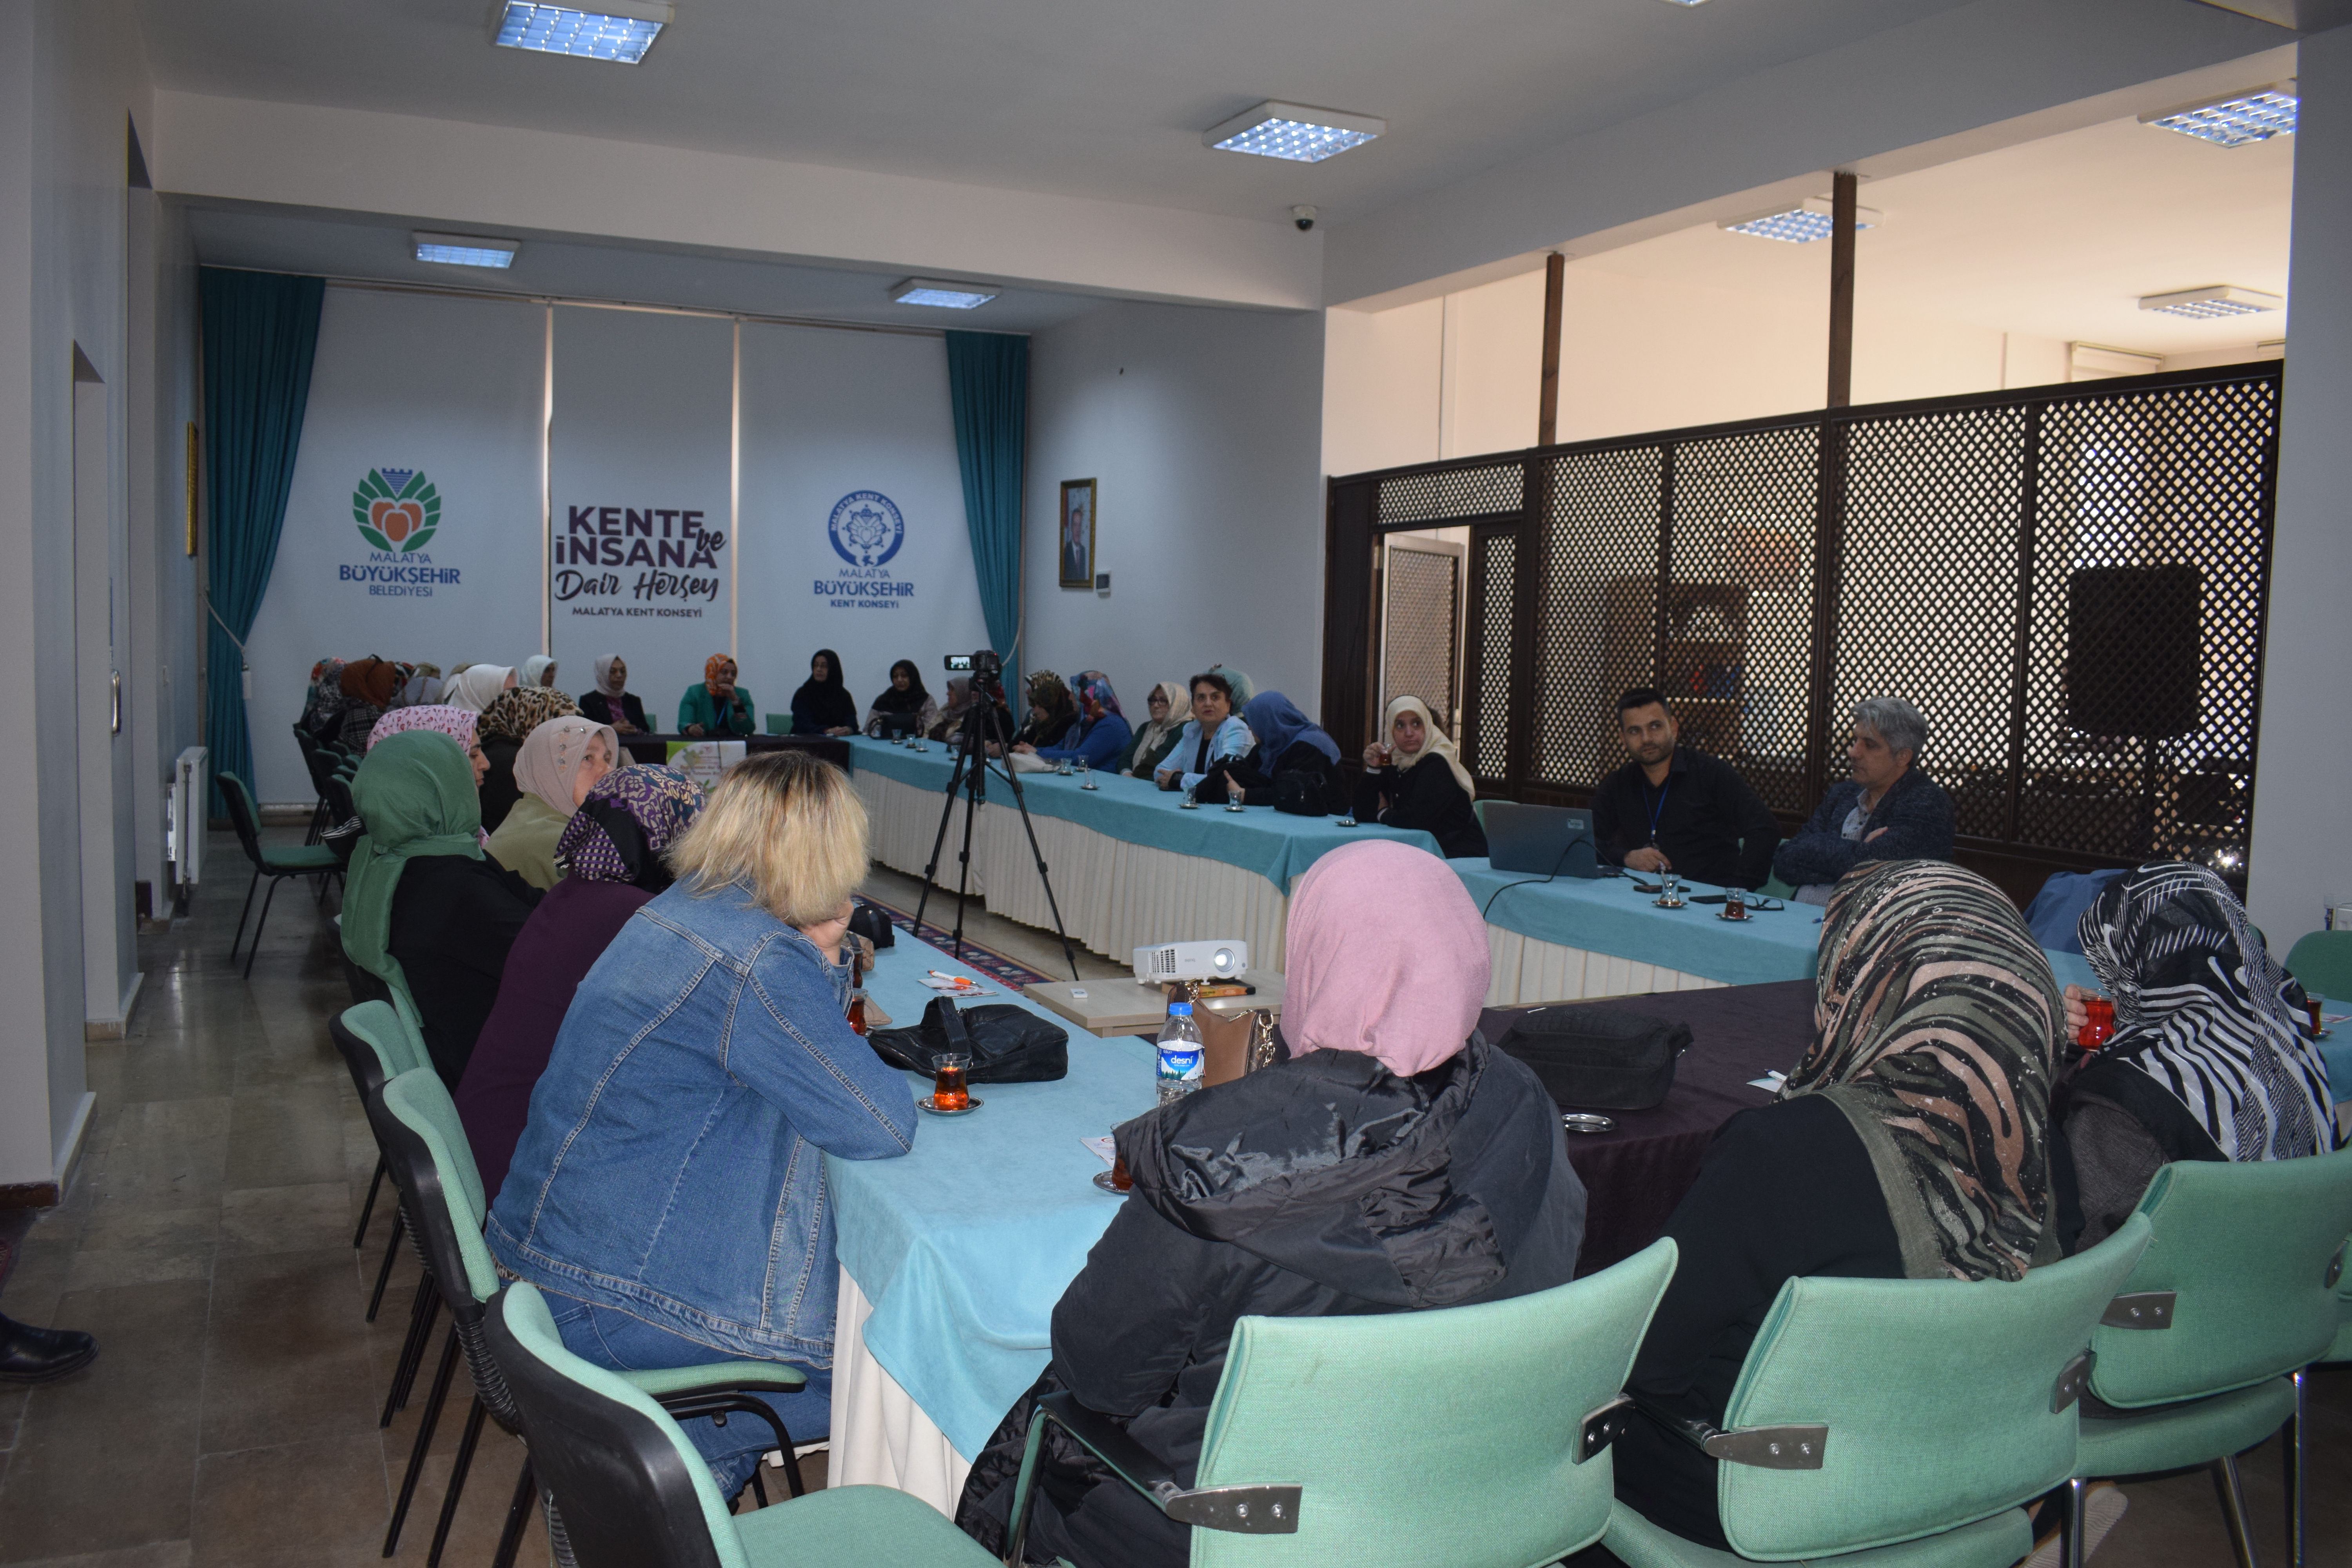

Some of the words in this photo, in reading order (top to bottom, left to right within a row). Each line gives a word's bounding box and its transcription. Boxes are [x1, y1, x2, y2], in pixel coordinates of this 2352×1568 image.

[568, 505, 704, 539] KENTE
[696, 528, 727, 552] ve
[369, 552, 432, 563] MALATYA
[839, 568, 891, 578] MALATYA
[554, 569, 622, 601] Dair
[633, 569, 719, 602] Herşey
[830, 599, 856, 608] KENT
[572, 606, 624, 617] MALATYA
[626, 607, 655, 617] KENT
